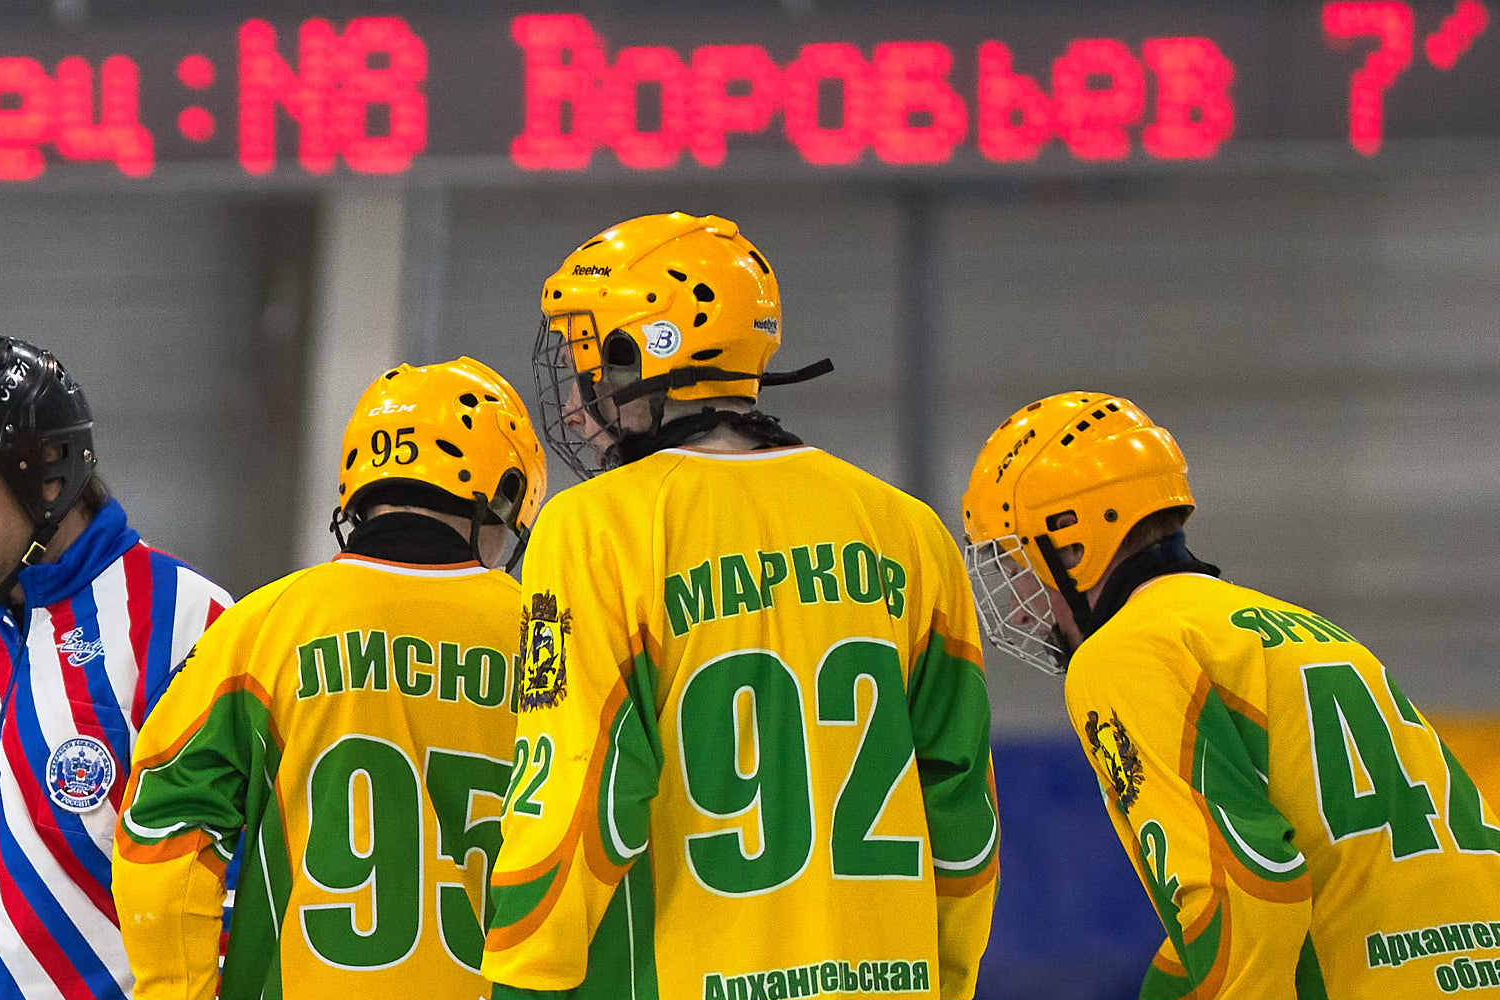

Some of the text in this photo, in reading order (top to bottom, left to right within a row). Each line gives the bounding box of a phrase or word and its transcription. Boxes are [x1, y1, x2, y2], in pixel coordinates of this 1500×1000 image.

[510, 13, 1236, 169] Воробьев
[572, 265, 612, 277] Reebok
[371, 427, 419, 467] 95
[664, 541, 907, 638] МАРКОВ
[677, 637, 924, 898] 92
[299, 733, 516, 974] 95
